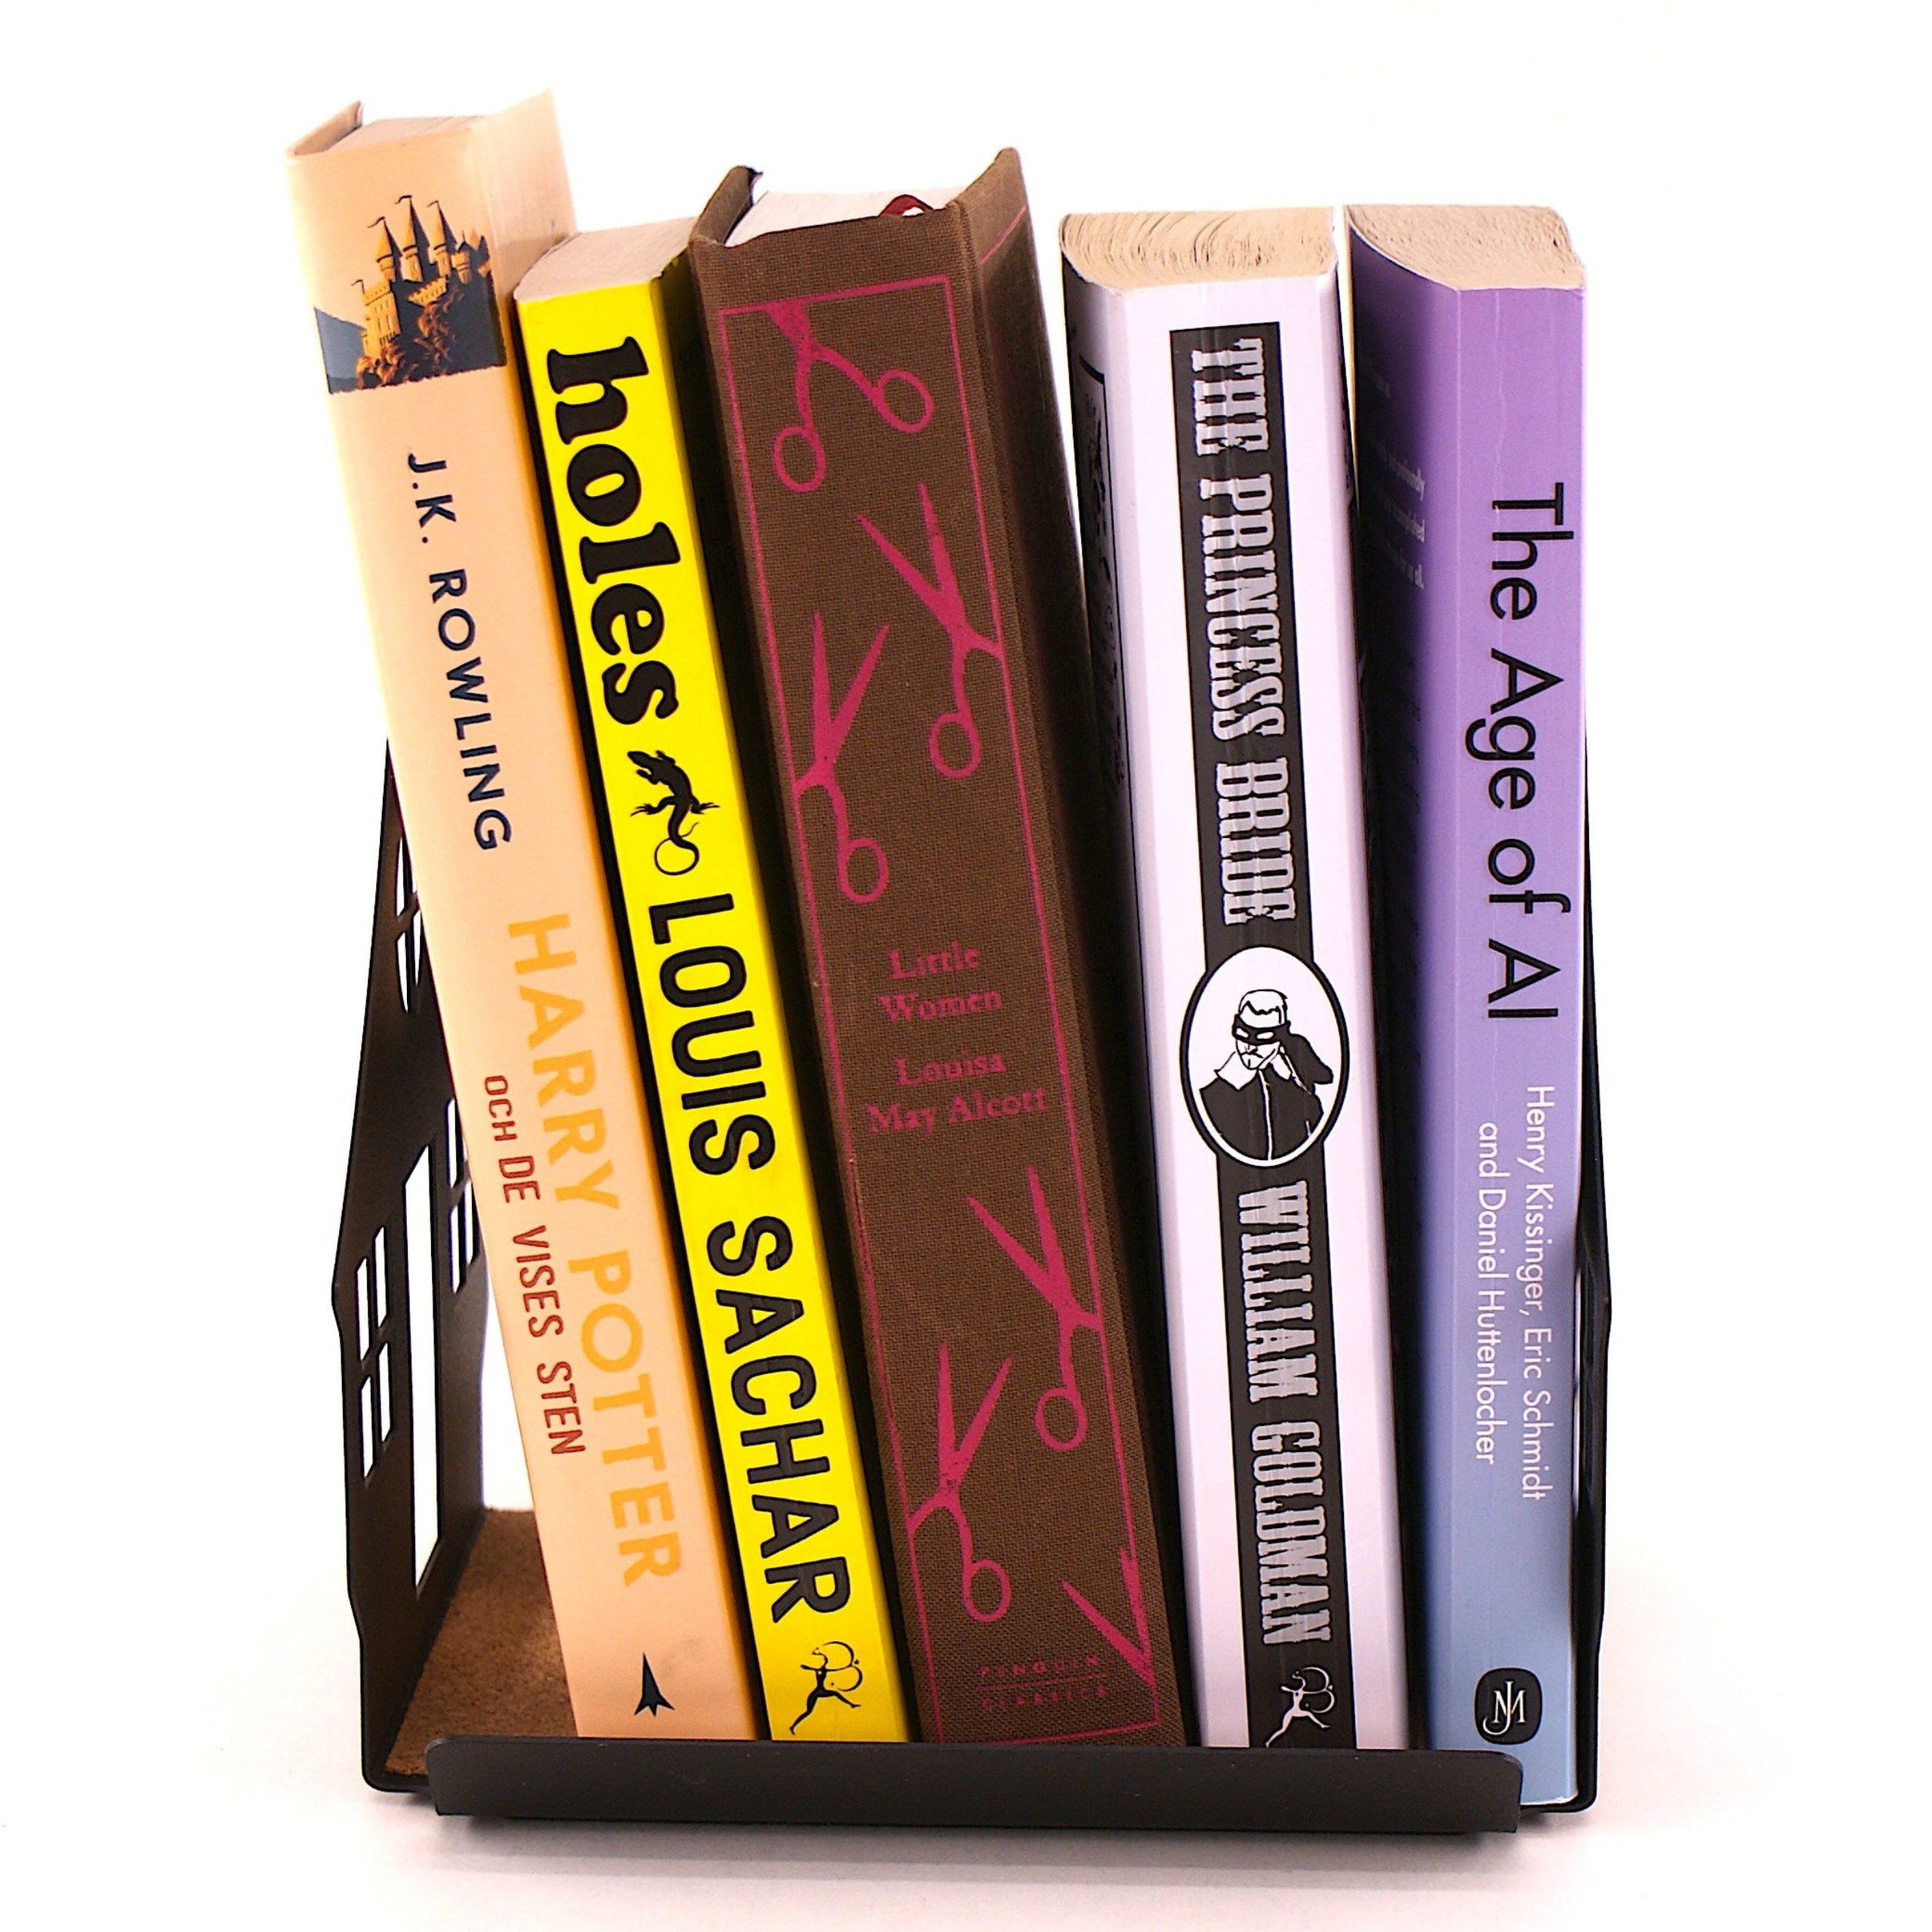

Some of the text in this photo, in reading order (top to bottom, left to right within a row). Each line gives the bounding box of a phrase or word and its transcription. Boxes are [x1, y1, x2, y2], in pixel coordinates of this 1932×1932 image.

[408, 452, 513, 851] J.K. ROWLING
[546, 336, 681, 726] holes
[1191, 337, 1296, 927] THE PRINCESS BRIDE
[1465, 481, 1574, 1019] The Age of AI
[867, 1087, 1046, 1137] May Alcott
[877, 989, 1003, 1024] Women
[886, 939, 981, 979] Little
[895, 1048, 1007, 1086] Louisa
[484, 1074, 586, 1456] OCH DE VISES STEN
[508, 913, 682, 1588] HARRY POTTER
[649, 892, 852, 1625] LOUIS SACHAR
[1237, 1179, 1333, 1646] WILLIAM GOLDMAN
[1474, 1122, 1511, 1465] and Daniel Huttenlocher
[1515, 1084, 1555, 1501] Henry Kissinger, Eric Schmidt
